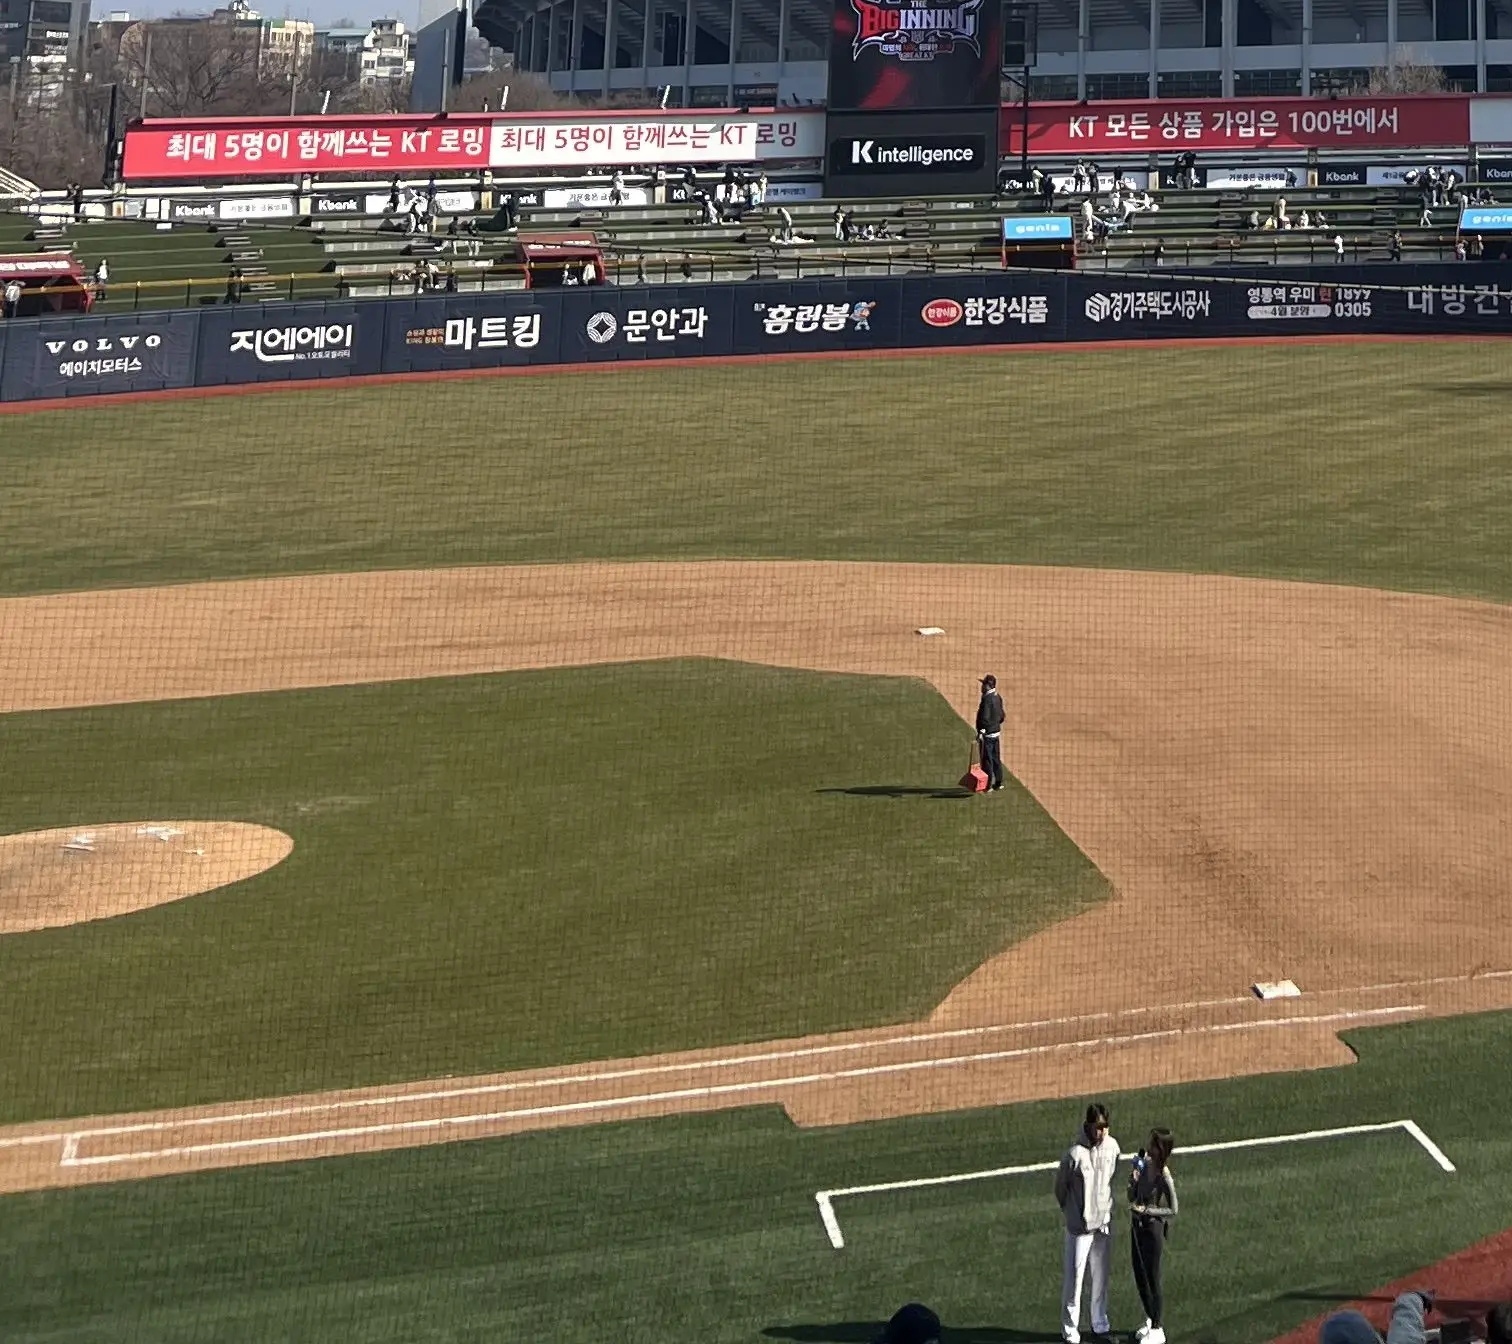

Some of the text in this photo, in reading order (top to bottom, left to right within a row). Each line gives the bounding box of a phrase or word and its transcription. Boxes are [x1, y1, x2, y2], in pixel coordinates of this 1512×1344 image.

[910, 0, 928, 9] THE
[1069, 106, 1399, 140] KT 모든 상품 가입은 100번에서
[166, 126, 485, 162] 최대 5명이 함께쓰는 KT 로밍
[500, 121, 798, 153] 최대 5명이 함께쓰는 KT 로밍
[852, 141, 974, 166] K intelligence
[1325, 171, 1359, 182] Kbank
[175, 204, 215, 217] Kbank
[318, 199, 358, 210] Kbank
[1110, 289, 1211, 321] 경기주택도시공사
[1289, 286, 1315, 303] 우미
[763, 302, 851, 335] 홈런볼
[964, 295, 1049, 326] 한강식품
[1335, 301, 1372, 318] 0305
[445, 313, 541, 350] 마트킹
[622, 306, 709, 342] 문안과
[45, 334, 161, 354] VOLVO
[59, 356, 142, 377] 에이치모터스
